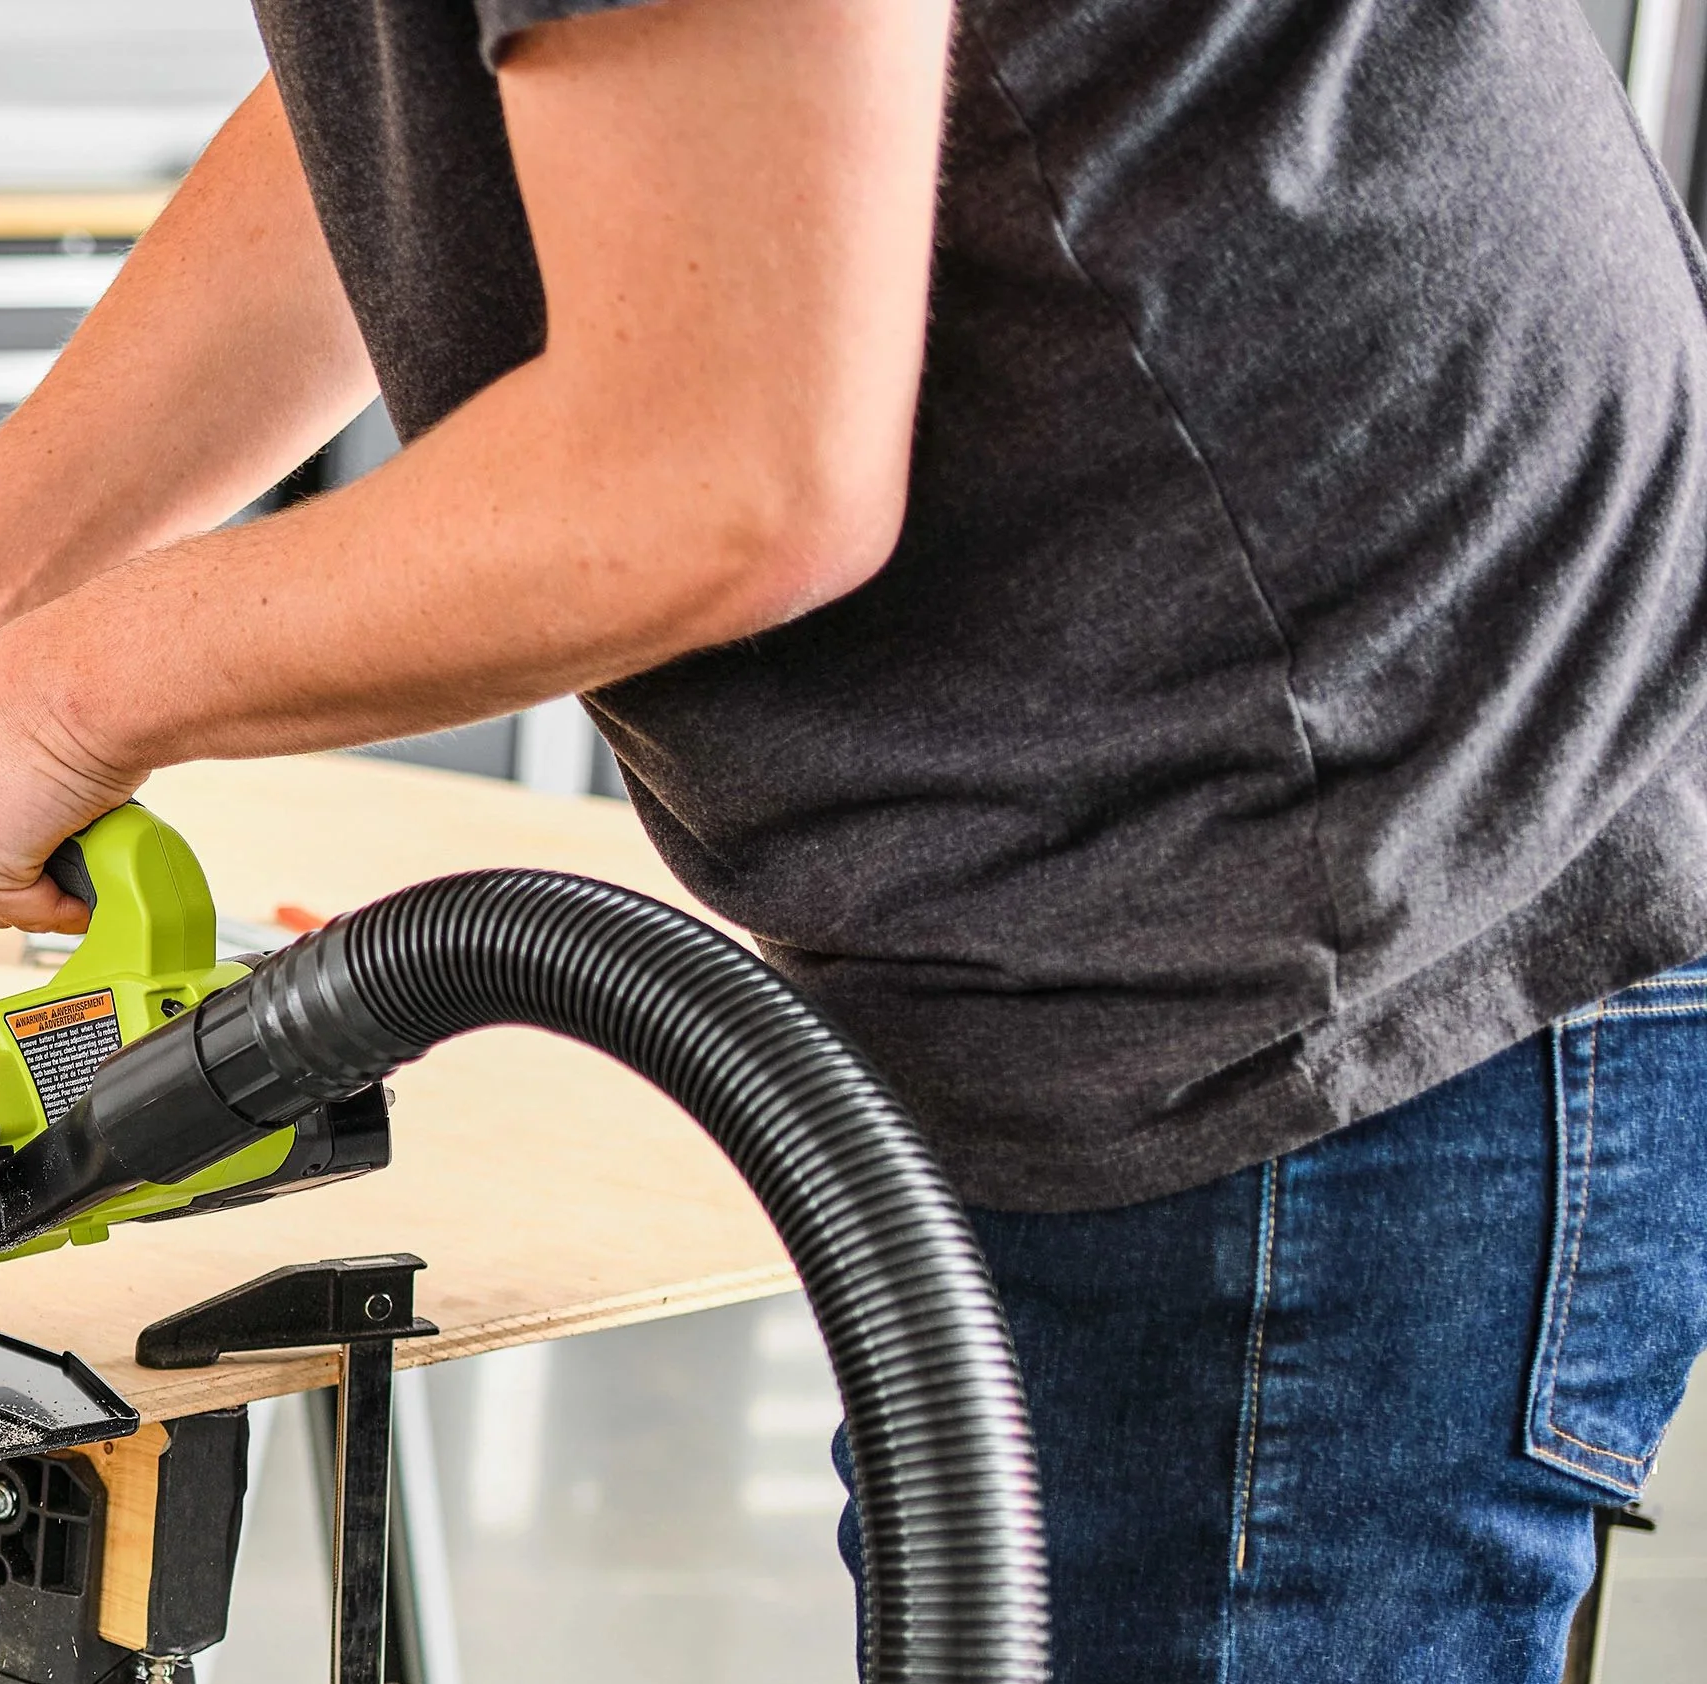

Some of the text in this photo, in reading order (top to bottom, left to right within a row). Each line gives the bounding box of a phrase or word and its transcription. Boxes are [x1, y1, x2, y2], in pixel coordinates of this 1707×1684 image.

[57, 996, 104, 1016] AVERTISSEMENT
[21, 1011, 48, 1026] WARNING
[45, 1012, 85, 1029] ADVERTENCIA
[39, 1035, 55, 1044] battery
[69, 1028, 79, 1036] tool
[81, 1025, 93, 1033] when
[95, 1019, 116, 1029] changing
[54, 1039, 70, 1048] making
[103, 1027, 117, 1036] reduce
[59, 1055, 70, 1064] blade
[89, 1047, 99, 1056] Hold
[63, 1045, 77, 1054] check
[33, 1070, 43, 1078] both
[58, 1062, 75, 1072] Support
[75, 1060, 83, 1068] and
